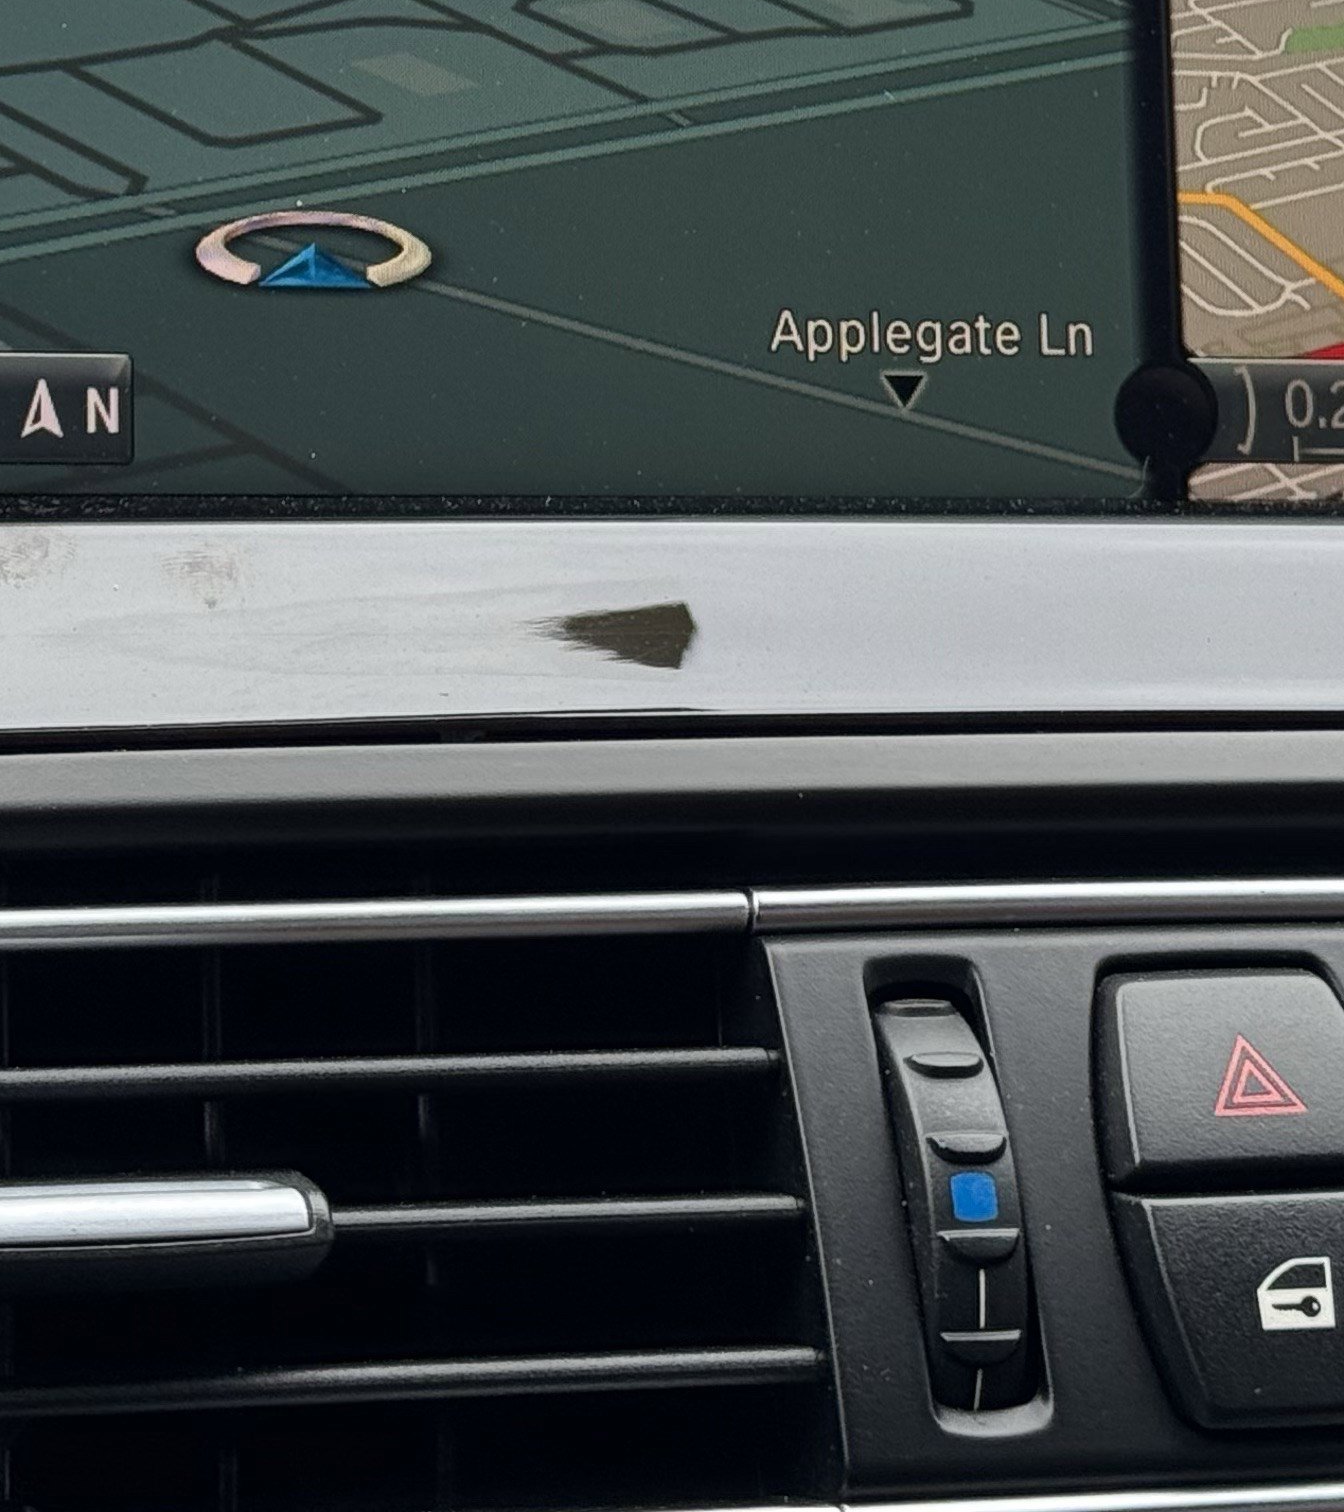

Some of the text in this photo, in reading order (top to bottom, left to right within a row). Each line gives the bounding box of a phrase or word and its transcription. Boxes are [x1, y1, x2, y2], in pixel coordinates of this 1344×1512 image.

[770, 309, 1094, 363] Applegate Ln
[87, 387, 120, 434] N
